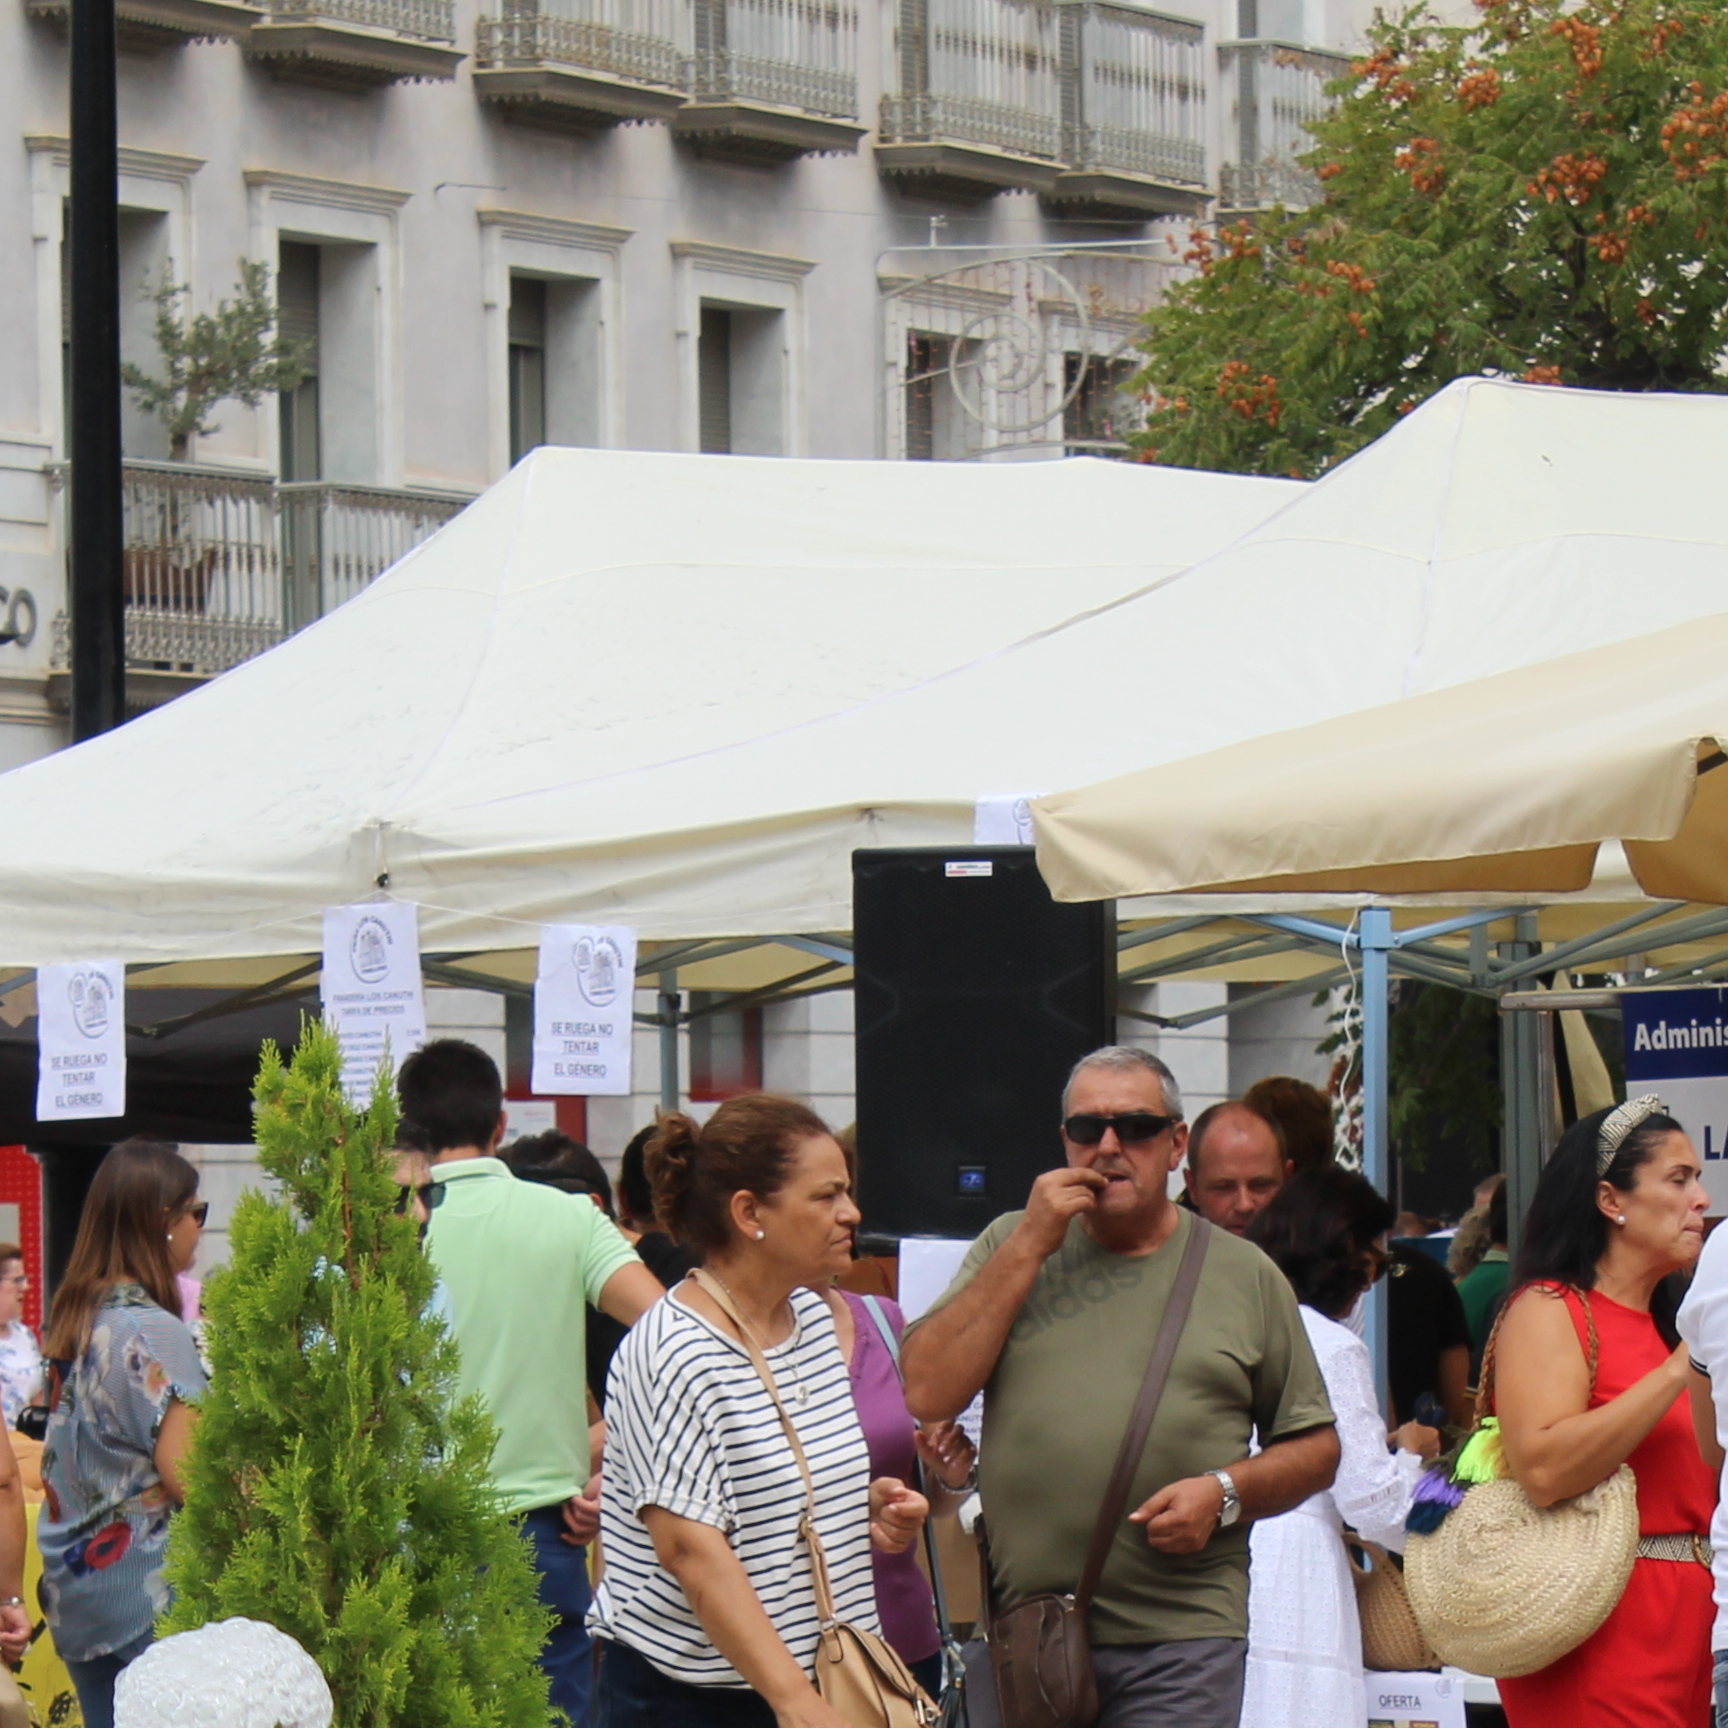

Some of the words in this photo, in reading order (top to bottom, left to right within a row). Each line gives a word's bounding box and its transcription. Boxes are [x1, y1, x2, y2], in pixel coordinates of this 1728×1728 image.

[551, 1021, 563, 1034] SE
[565, 1021, 596, 1034] RUEGA
[599, 1023, 614, 1035] NO
[563, 1040, 599, 1053] TENTAR
[51, 1056, 62, 1068] SE
[63, 1054, 91, 1067] RUEGA
[93, 1052, 108, 1065] NO
[554, 1063, 566, 1075] EL
[62, 1071, 95, 1085] TENTAR
[1378, 1694, 1422, 1708] OFERTA
